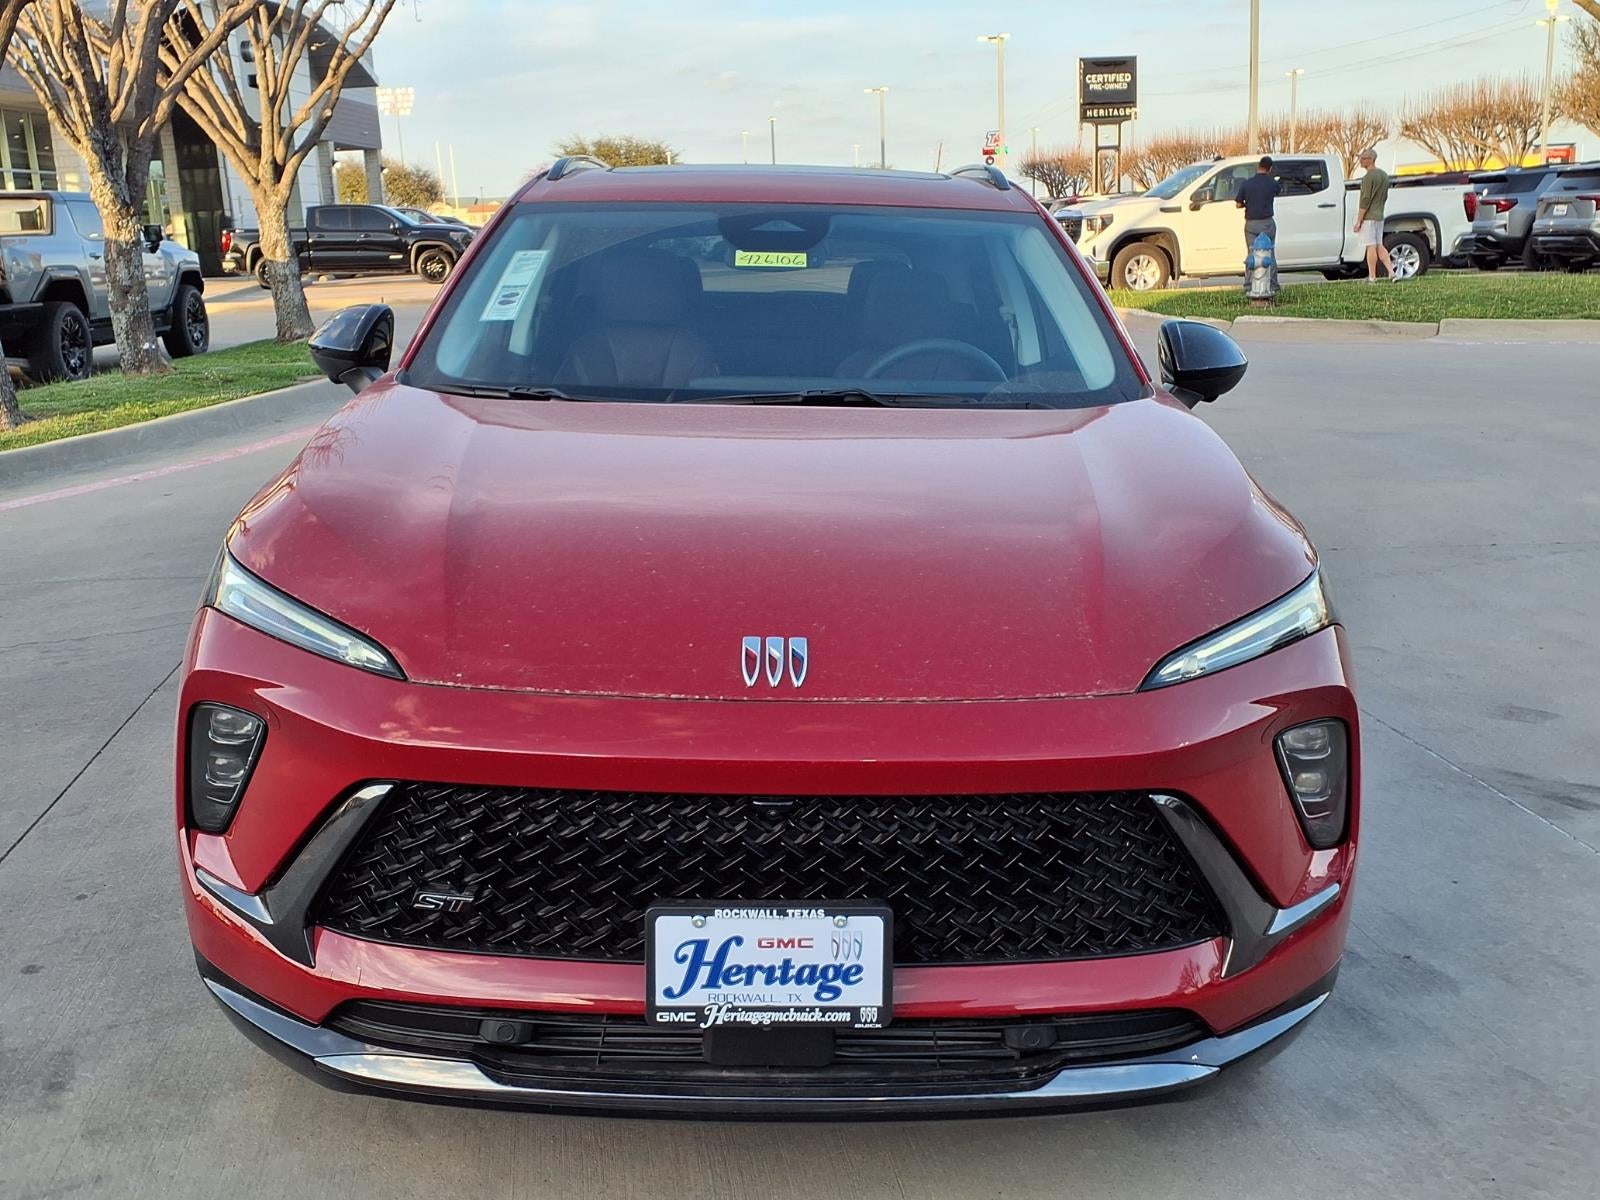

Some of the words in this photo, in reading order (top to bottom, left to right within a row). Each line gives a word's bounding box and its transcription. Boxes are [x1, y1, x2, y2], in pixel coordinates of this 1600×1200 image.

[1085, 73, 1132, 83] CERTIFIED
[740, 254, 805, 266] 426106
[413, 894, 474, 912] ST
[714, 908, 783, 920] ROCKWALL,
[786, 908, 825, 919] TEXAS
[757, 937, 814, 949] GMC
[662, 935, 864, 1002] Heritage
[787, 993, 802, 1003] TX
[656, 1012, 696, 1022] GMC
[700, 1002, 851, 1029] Heritagegmcbuick.com
